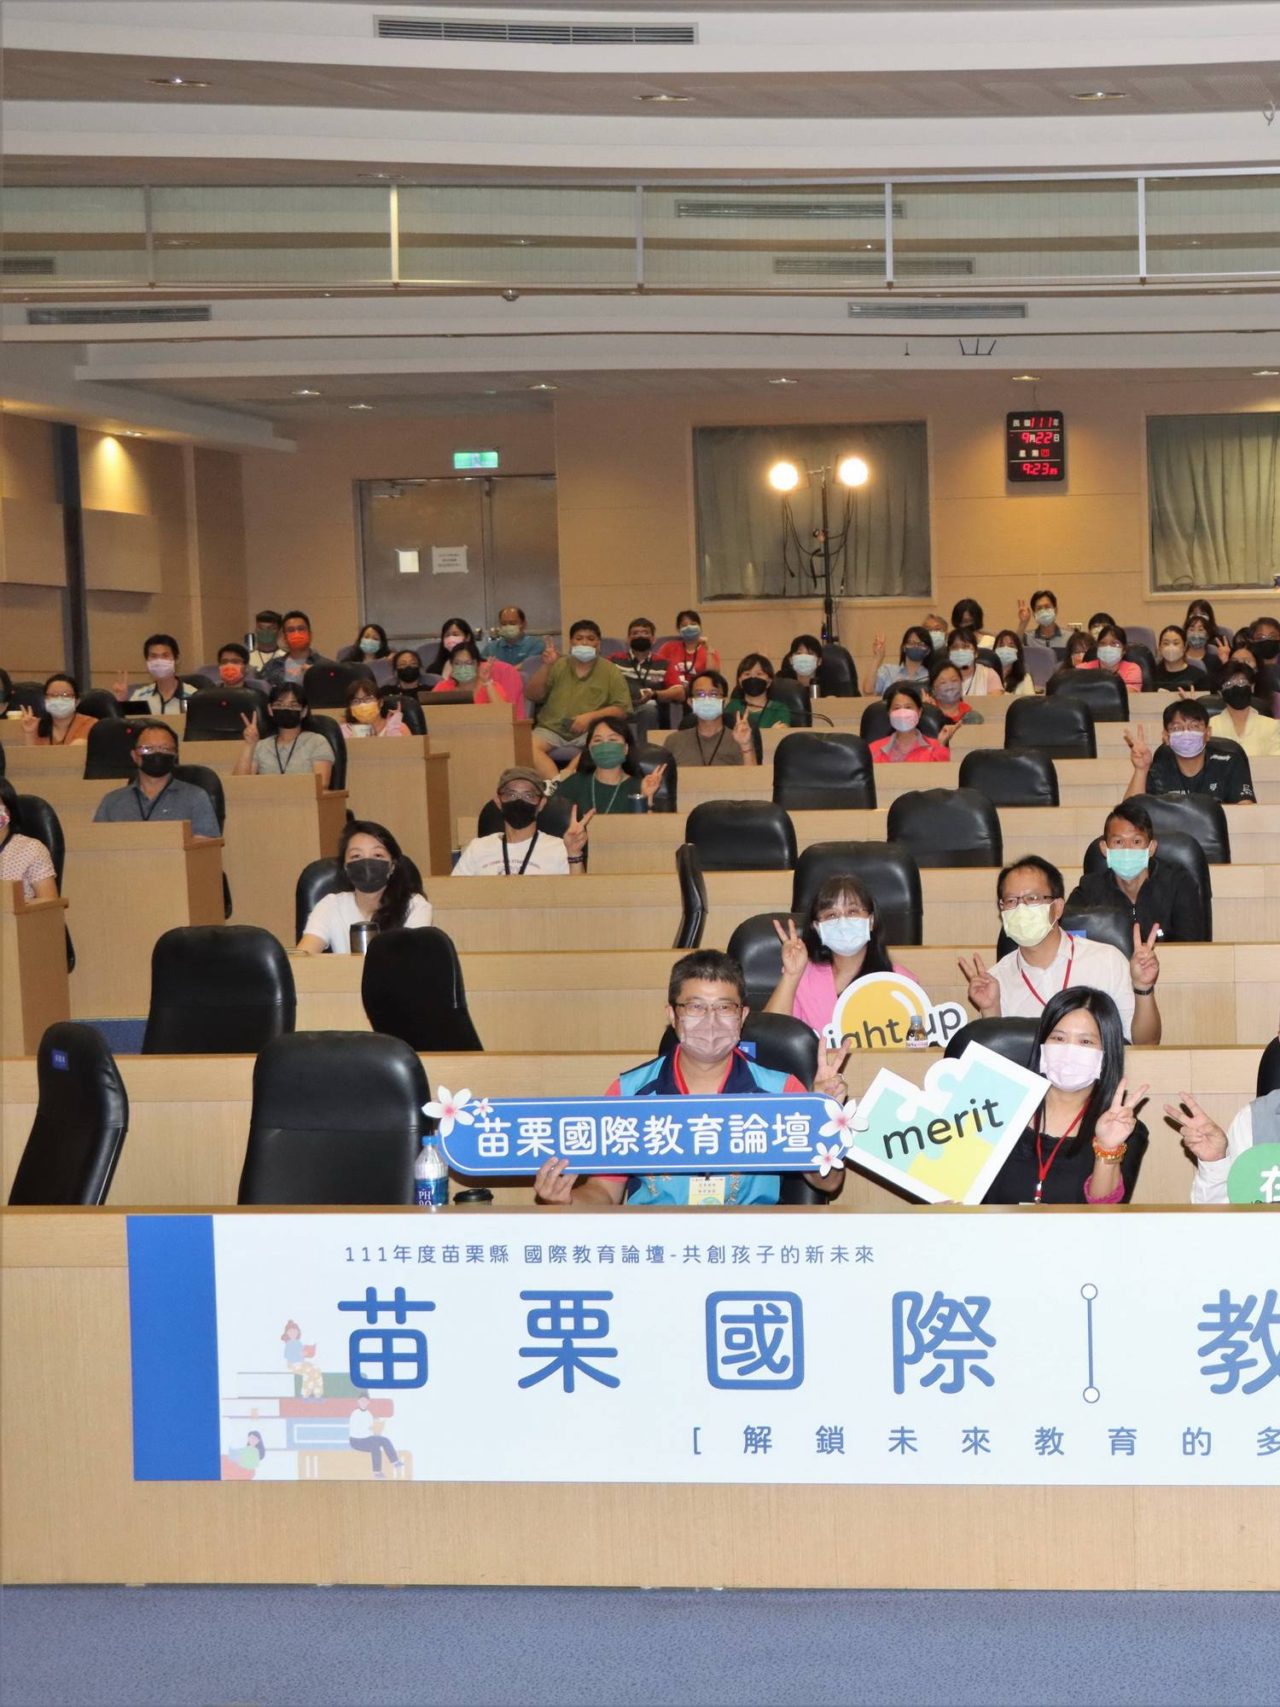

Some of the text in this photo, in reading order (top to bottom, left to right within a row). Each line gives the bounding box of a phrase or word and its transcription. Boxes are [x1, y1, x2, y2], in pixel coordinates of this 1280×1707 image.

[474, 1111, 814, 1158] 苗栗國際教育論壇
[882, 1098, 1005, 1160] merit
[345, 1244, 509, 1264] 111年度苗栗縣
